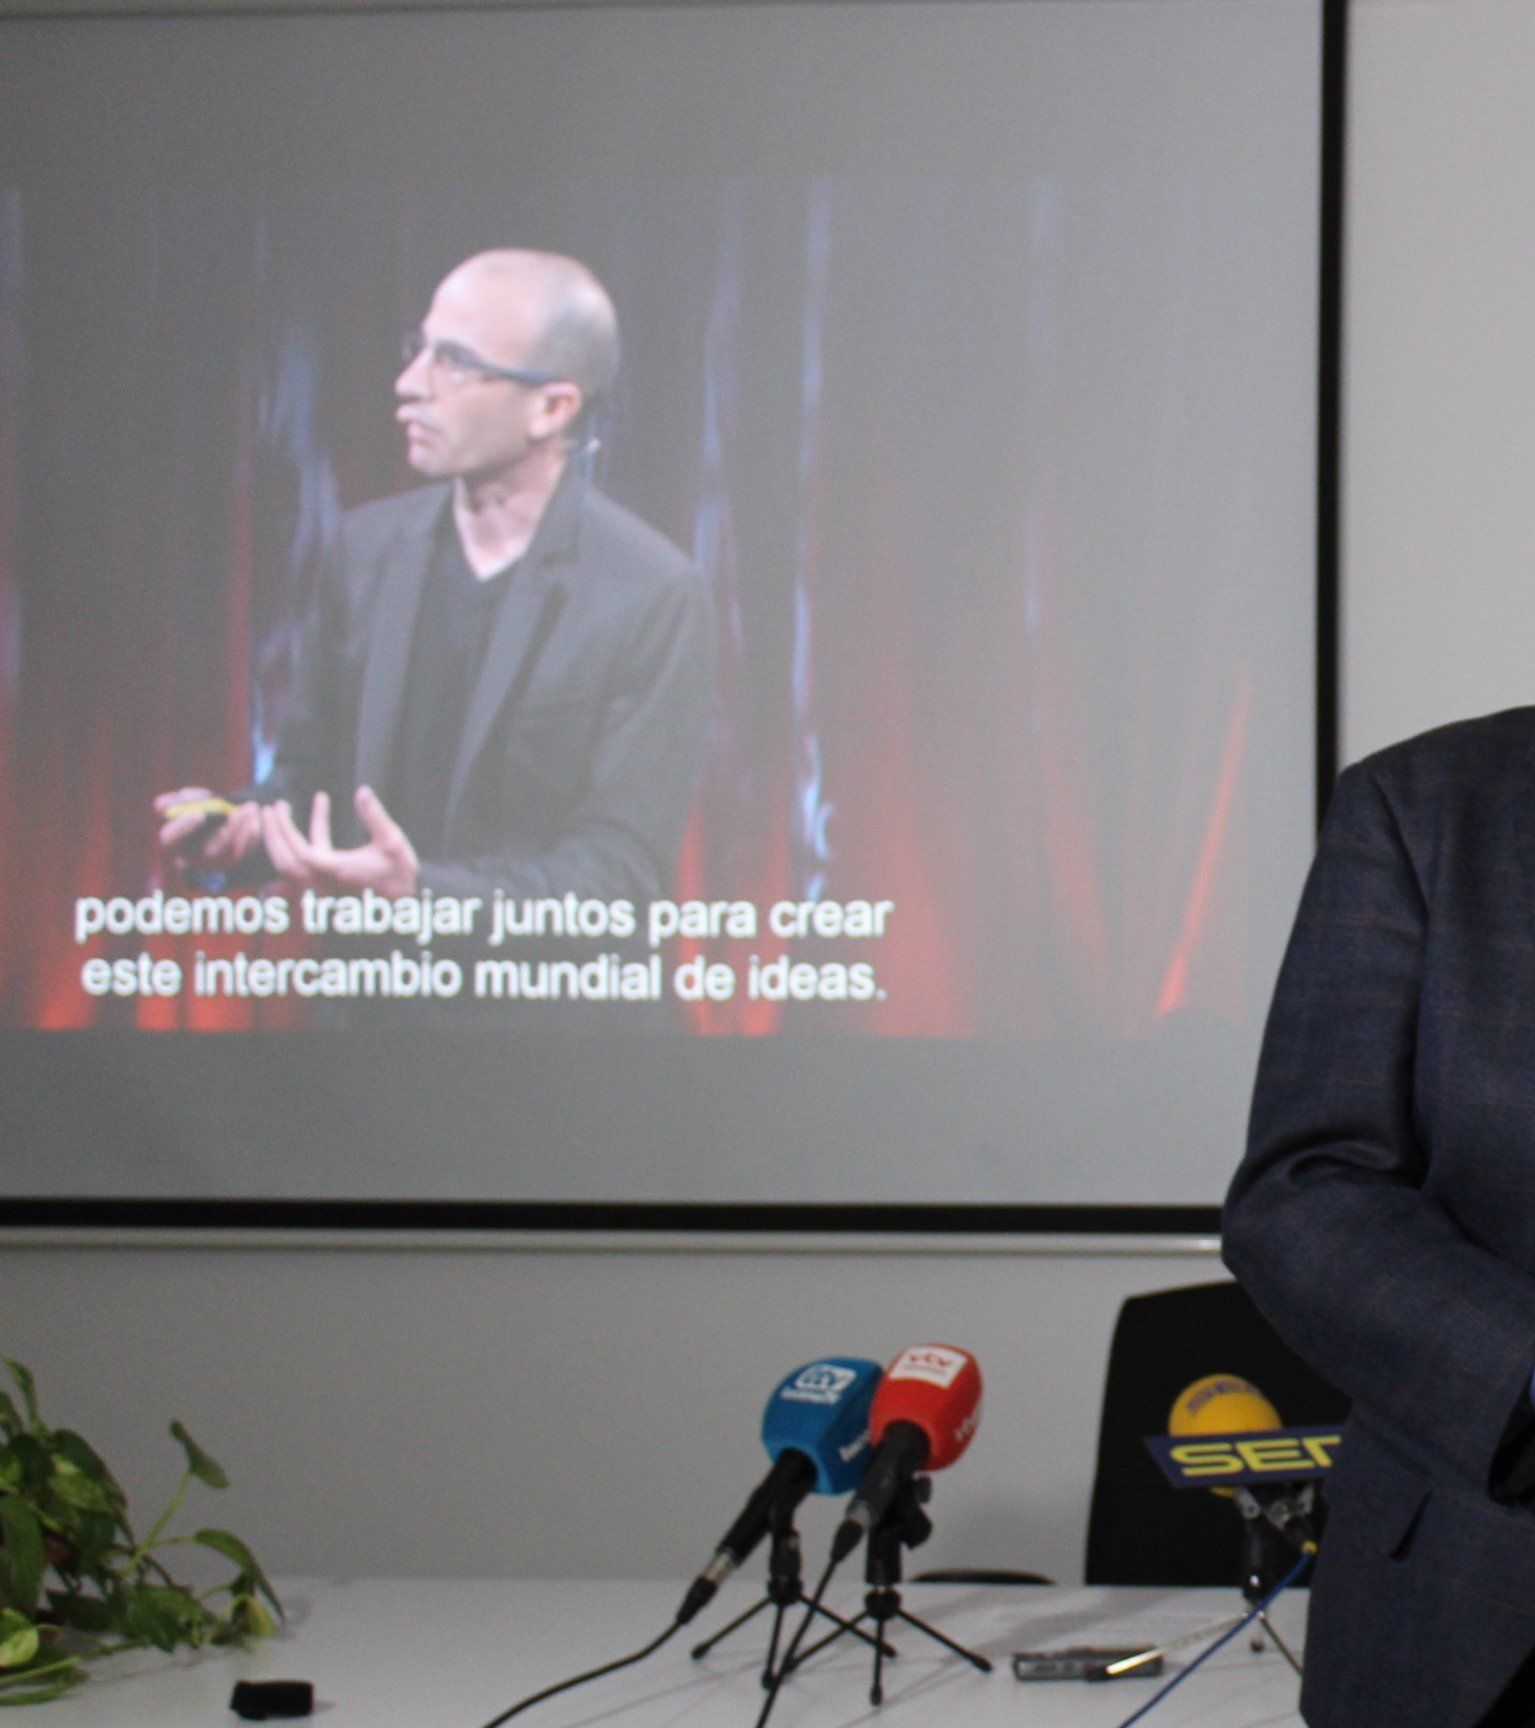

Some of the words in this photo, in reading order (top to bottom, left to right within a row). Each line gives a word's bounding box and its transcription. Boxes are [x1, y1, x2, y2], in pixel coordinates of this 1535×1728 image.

[74, 893, 290, 945] podemos
[300, 890, 482, 945] trabajar
[489, 889, 637, 946] juntos
[648, 901, 757, 947] para
[768, 900, 894, 937] crear
[81, 960, 182, 998] este
[195, 952, 464, 998] intercambio
[475, 952, 663, 1000] mundial
[674, 953, 735, 999] de
[747, 953, 887, 1000] ideas.
